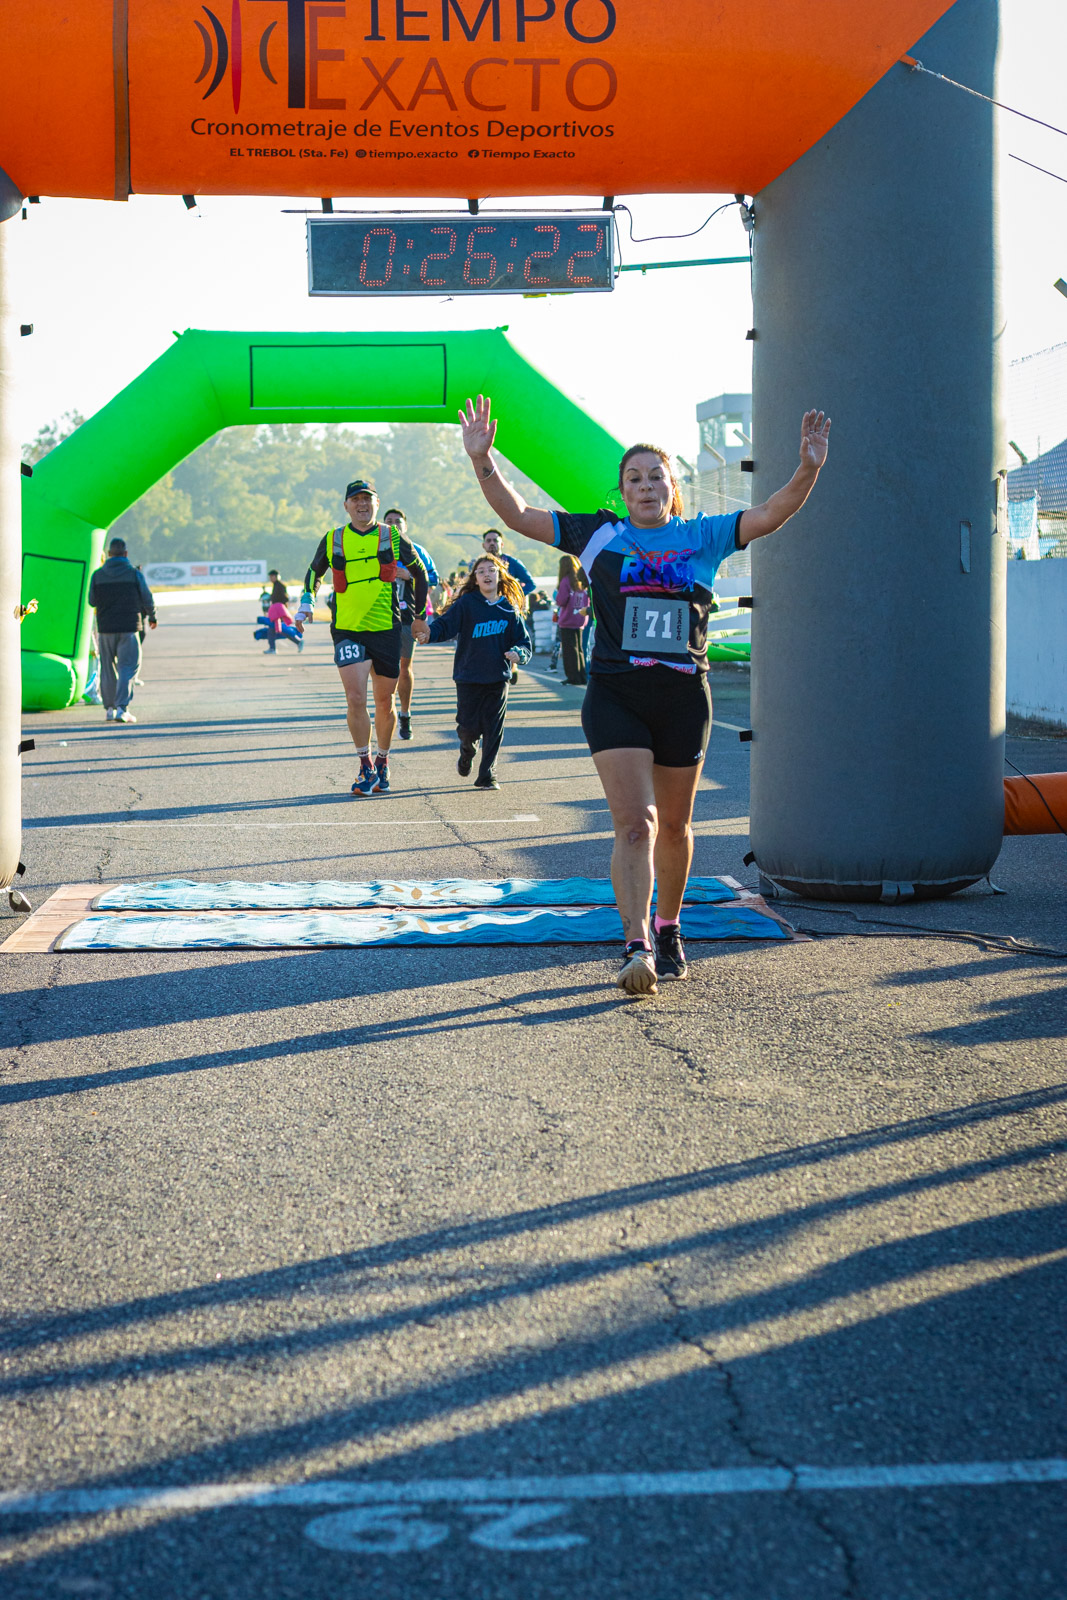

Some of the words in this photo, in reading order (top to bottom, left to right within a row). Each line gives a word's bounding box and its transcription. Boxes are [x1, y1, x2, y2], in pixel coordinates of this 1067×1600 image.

[190, 118, 348, 141] Cronometraje
[354, 119, 382, 137] de
[389, 120, 480, 138] Eventos
[487, 120, 615, 142] Deportivos
[230, 148, 244, 158] EL
[246, 148, 296, 158] TREBOL
[299, 148, 328, 160] (Sta.
[330, 148, 349, 160] Fe)
[368, 148, 459, 161] tiempo.exacto
[482, 149, 530, 161] Tiempo
[533, 149, 576, 160] Exacto
[358, 224, 604, 287] 0:26:22
[631, 606, 639, 639] TIEMPO
[645, 610, 672, 639] 71
[339, 644, 360, 661] 153
